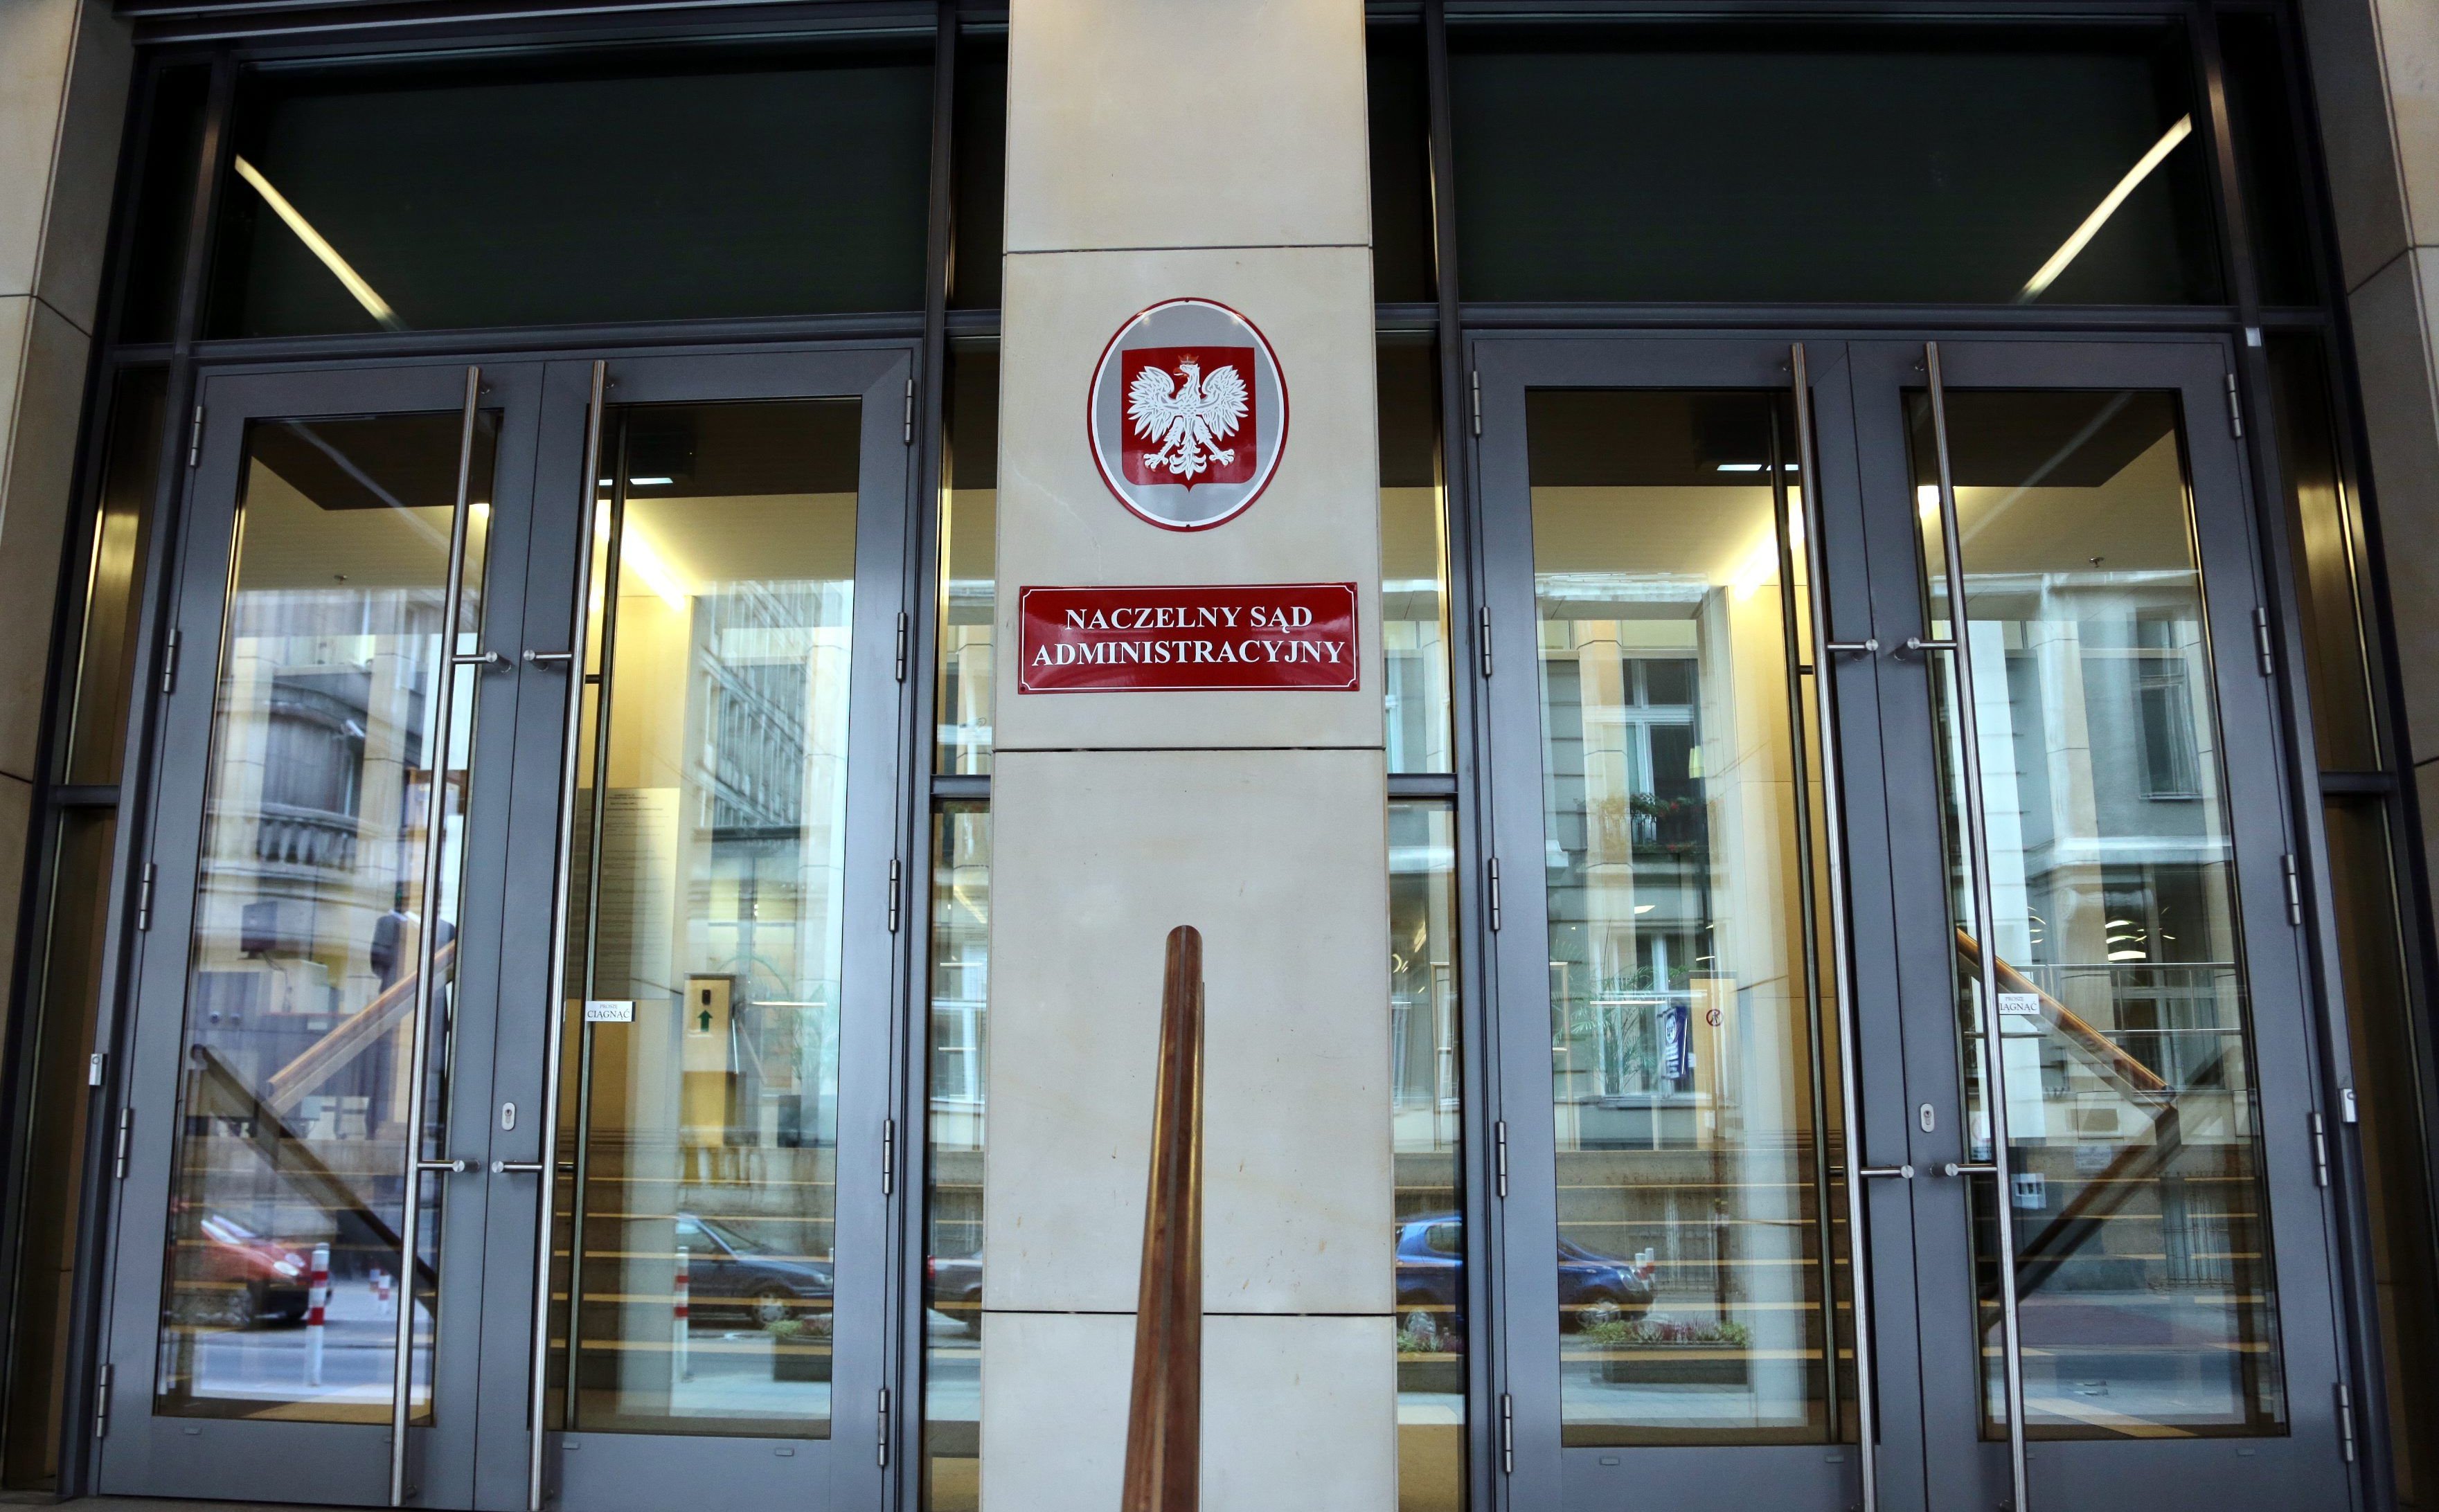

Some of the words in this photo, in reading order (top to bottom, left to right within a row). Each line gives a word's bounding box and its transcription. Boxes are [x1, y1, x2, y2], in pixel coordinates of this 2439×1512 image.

[1065, 606, 1242, 630] NACZELNY
[1250, 606, 1312, 633] SĄD
[1032, 640, 1346, 667] ADMINISTRACYJNY
[587, 1009, 630, 1020] CIĄGNĄĆ
[2000, 1001, 2037, 1013] IĄGNĄĆ
